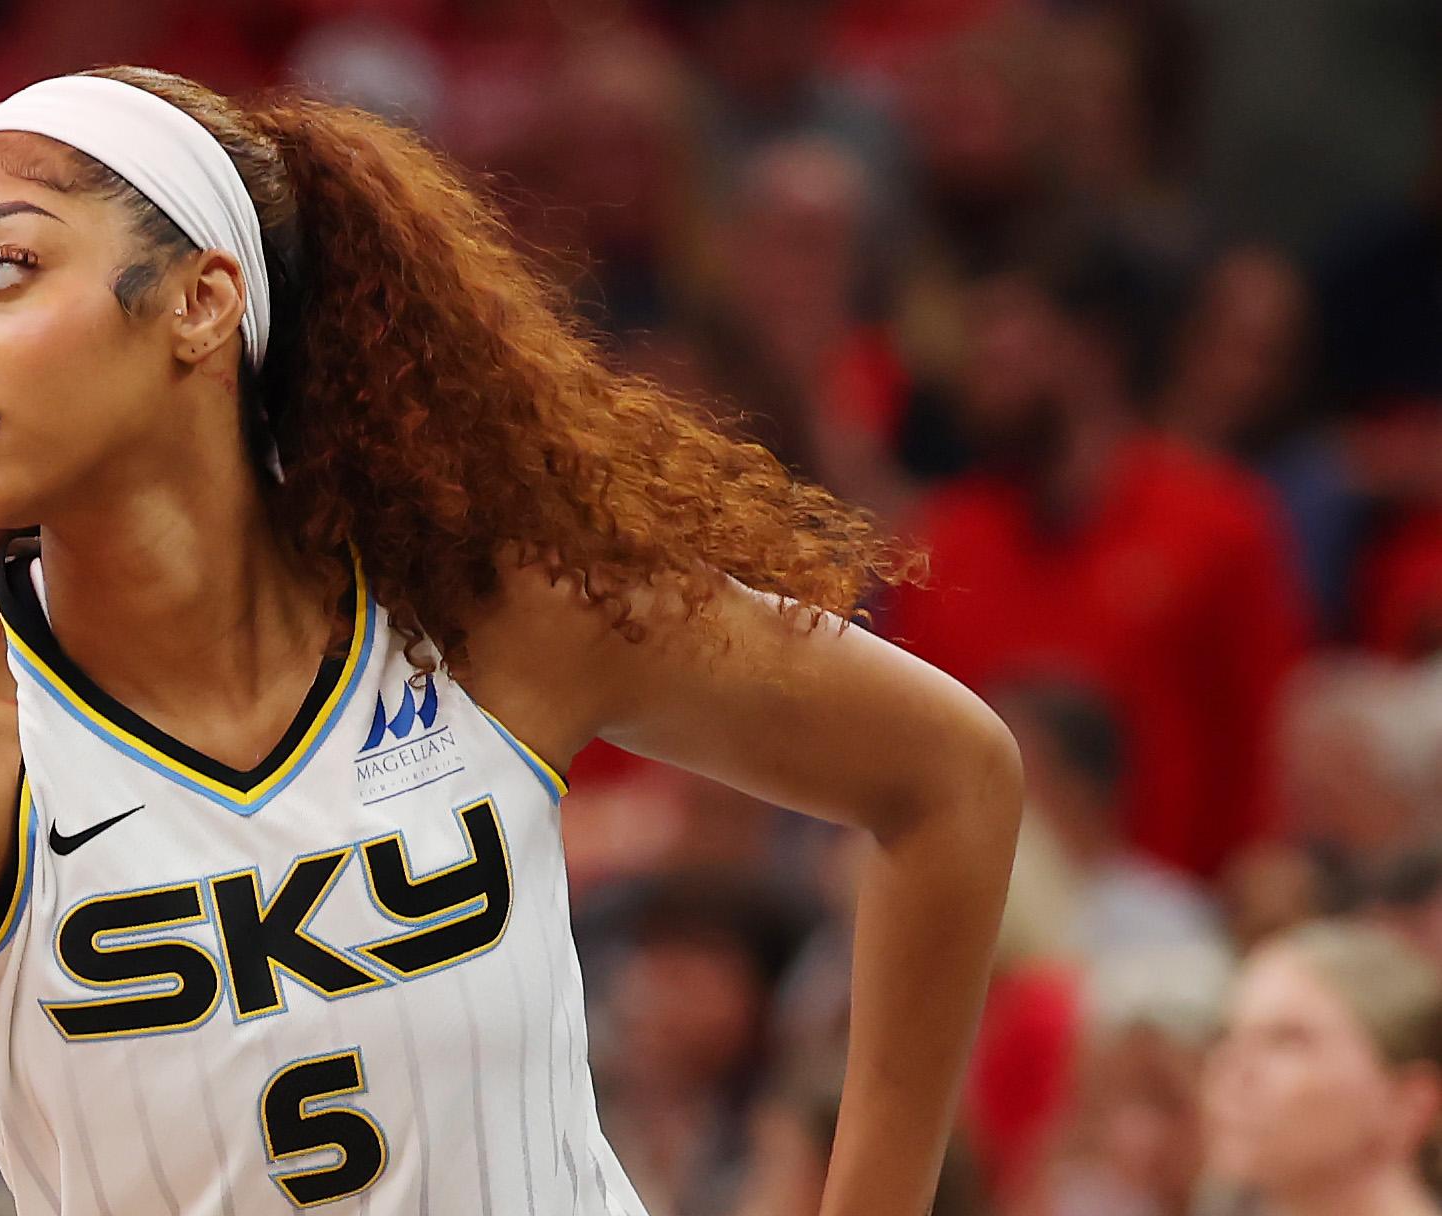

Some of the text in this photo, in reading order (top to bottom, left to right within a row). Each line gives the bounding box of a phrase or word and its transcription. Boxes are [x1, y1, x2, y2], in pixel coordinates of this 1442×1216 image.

[356, 731, 456, 783] MAGELLAN
[37, 794, 514, 1043] SKY
[257, 1044, 390, 1209] 5
